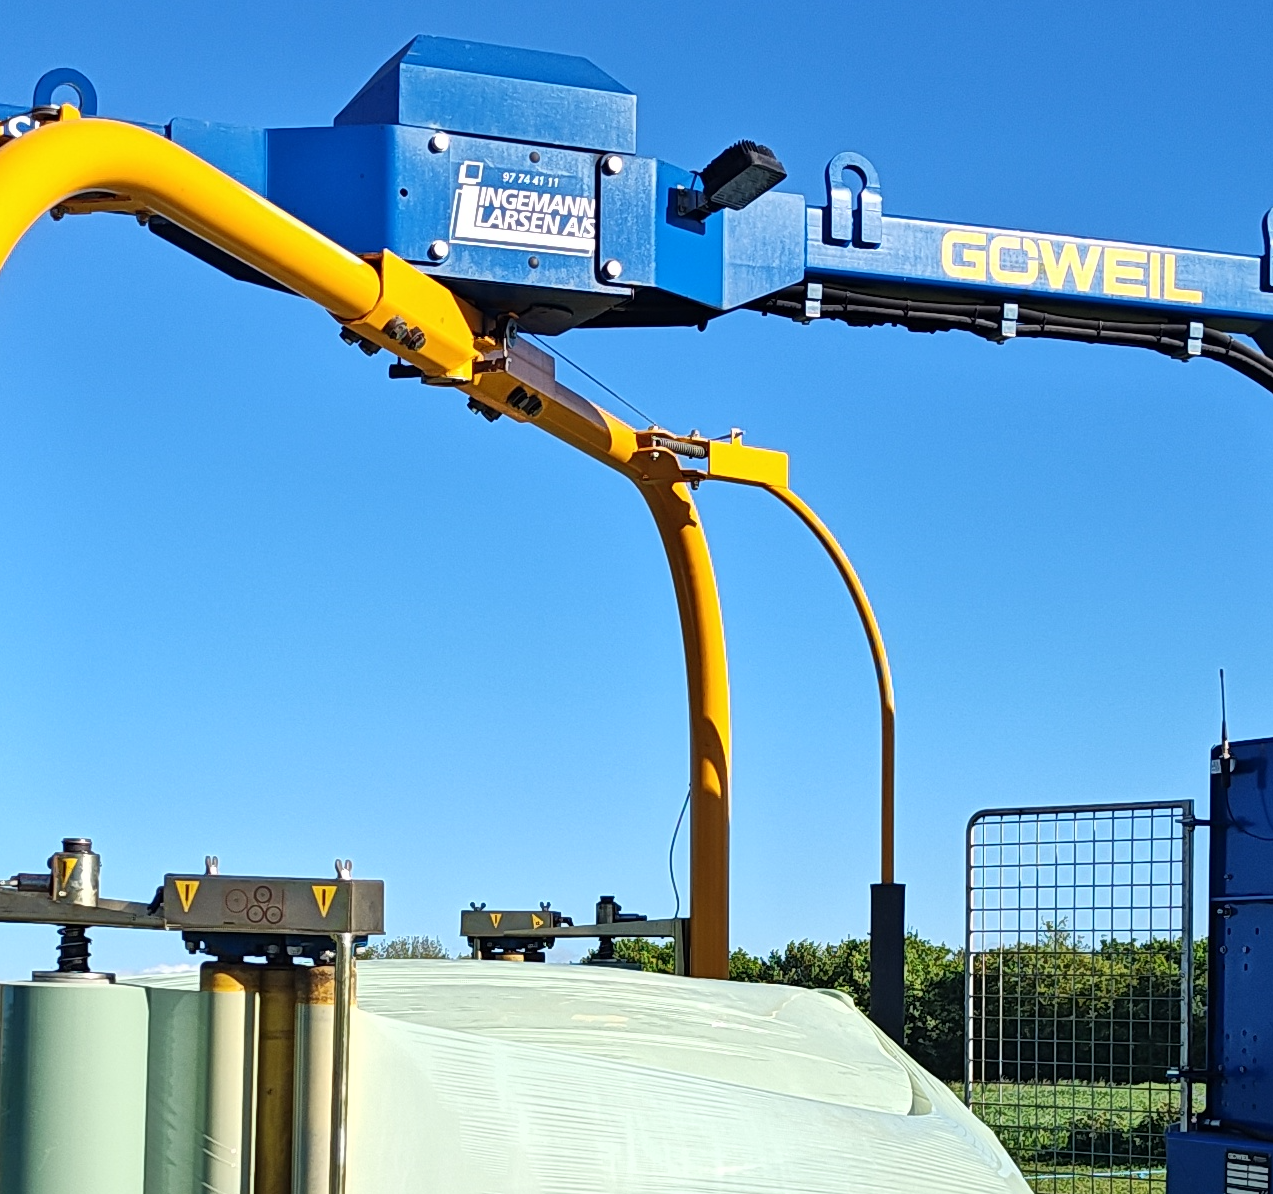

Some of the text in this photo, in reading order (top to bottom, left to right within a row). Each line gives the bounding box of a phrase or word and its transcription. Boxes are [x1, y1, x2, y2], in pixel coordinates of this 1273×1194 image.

[502, 172, 559, 188] 97 74 41 11
[478, 186, 596, 218] INGEMANN
[475, 206, 561, 235] LARSEN
